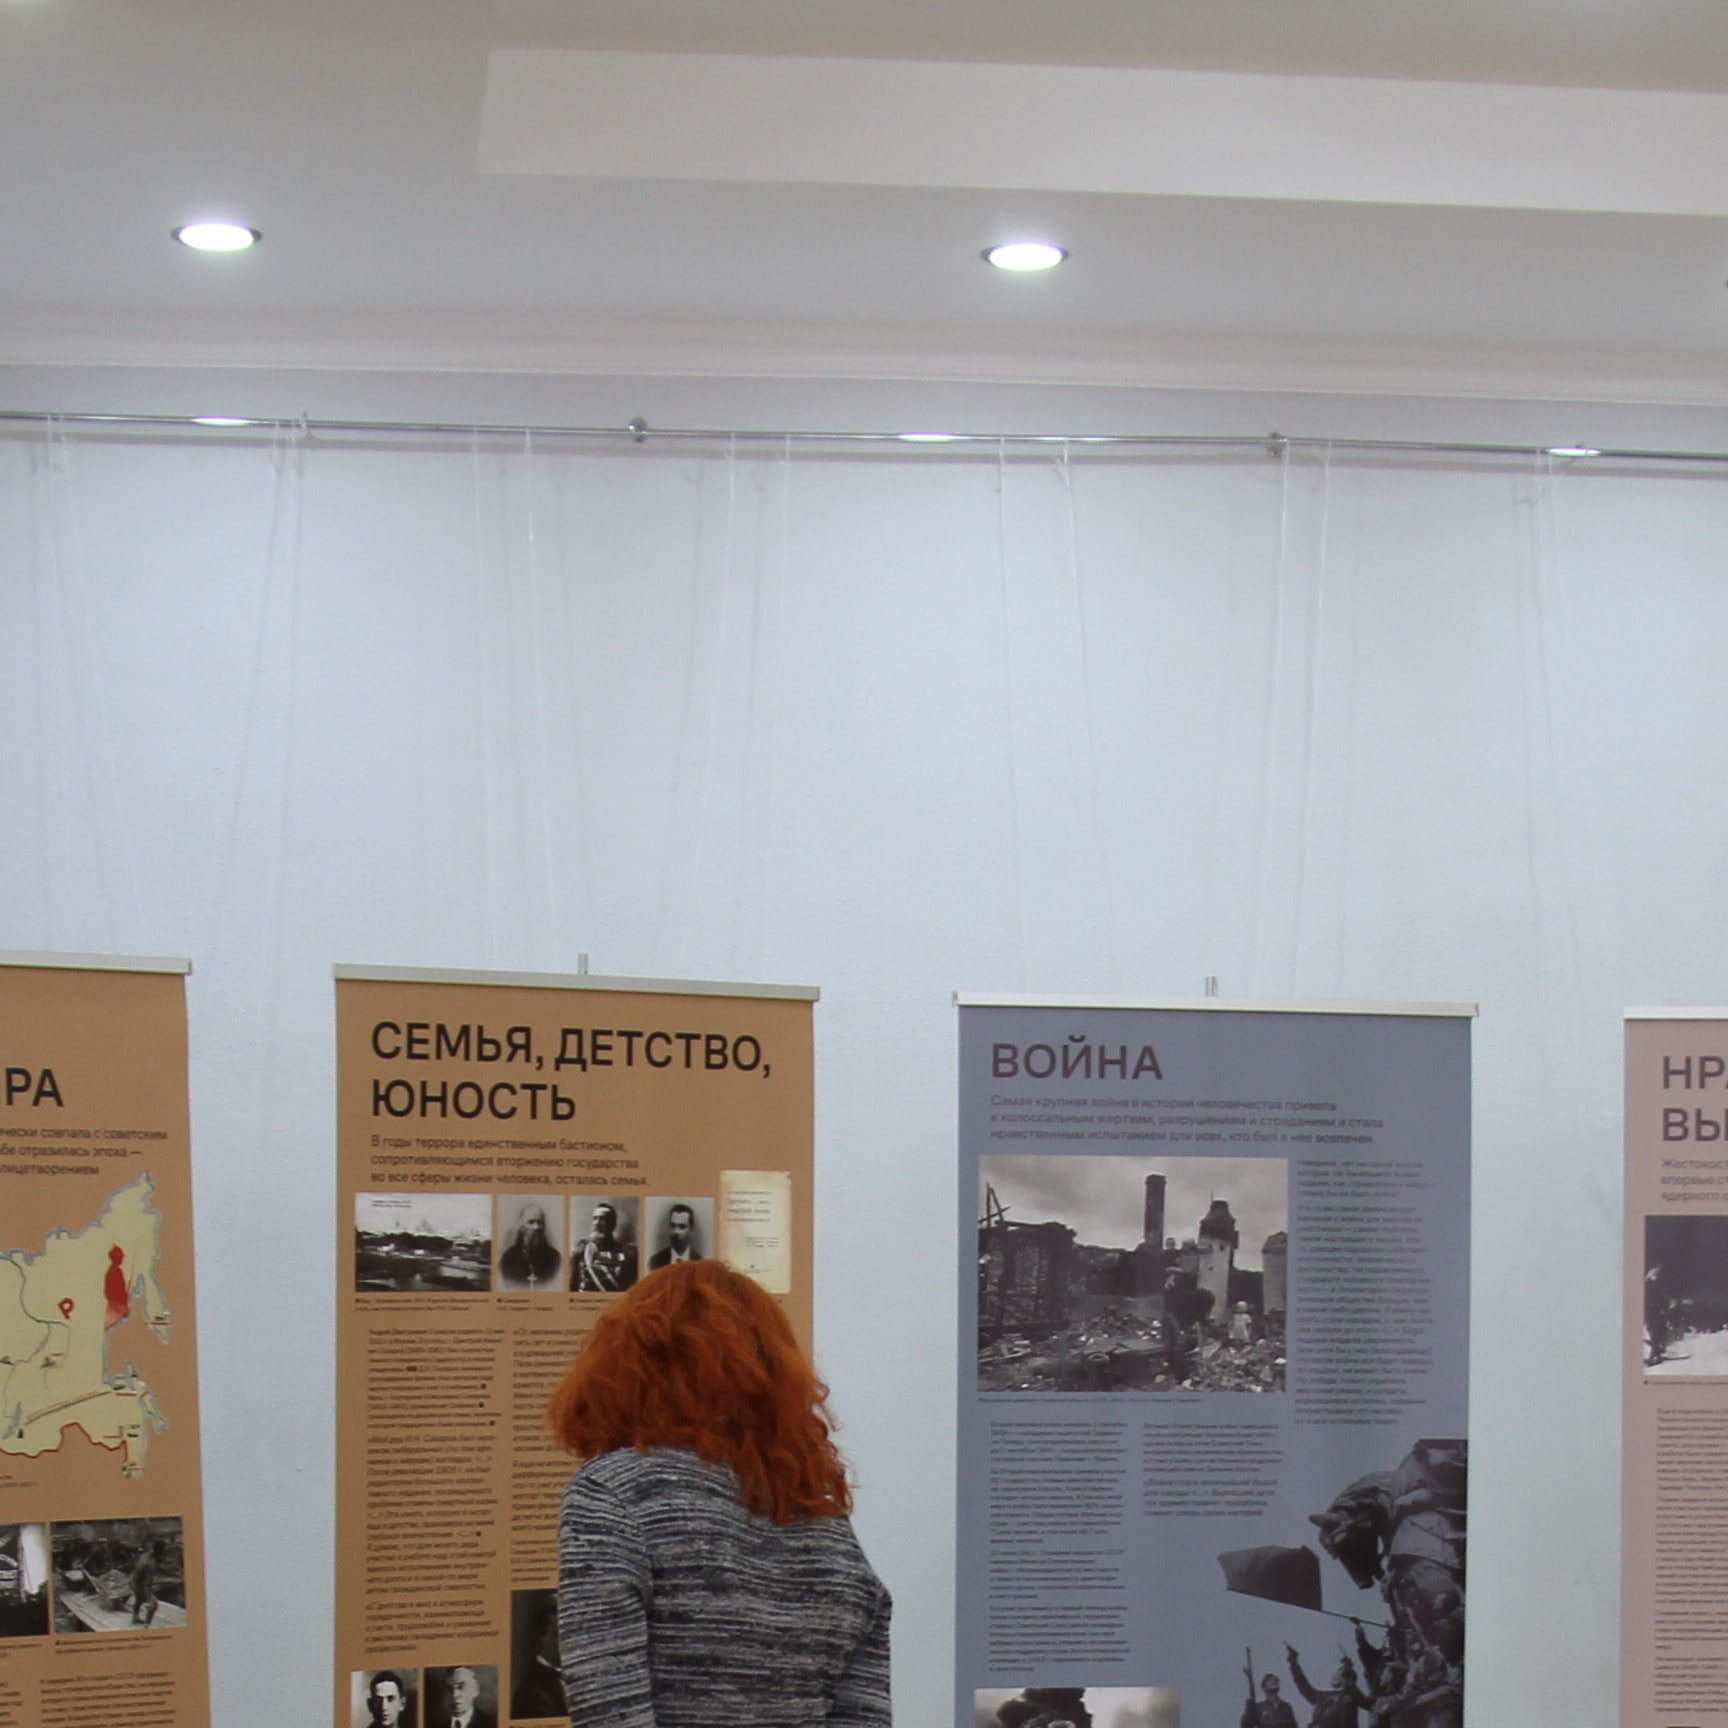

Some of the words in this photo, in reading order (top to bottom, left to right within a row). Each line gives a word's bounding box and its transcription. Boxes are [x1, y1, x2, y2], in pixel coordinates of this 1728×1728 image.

[372, 1021, 543, 1070] СЕМЬЯ,
[554, 1027, 771, 1078] ДЕТСТВО,
[992, 1034, 1163, 1081] ВОЙНА
[373, 1079, 576, 1121] ЮНОСТЬ
